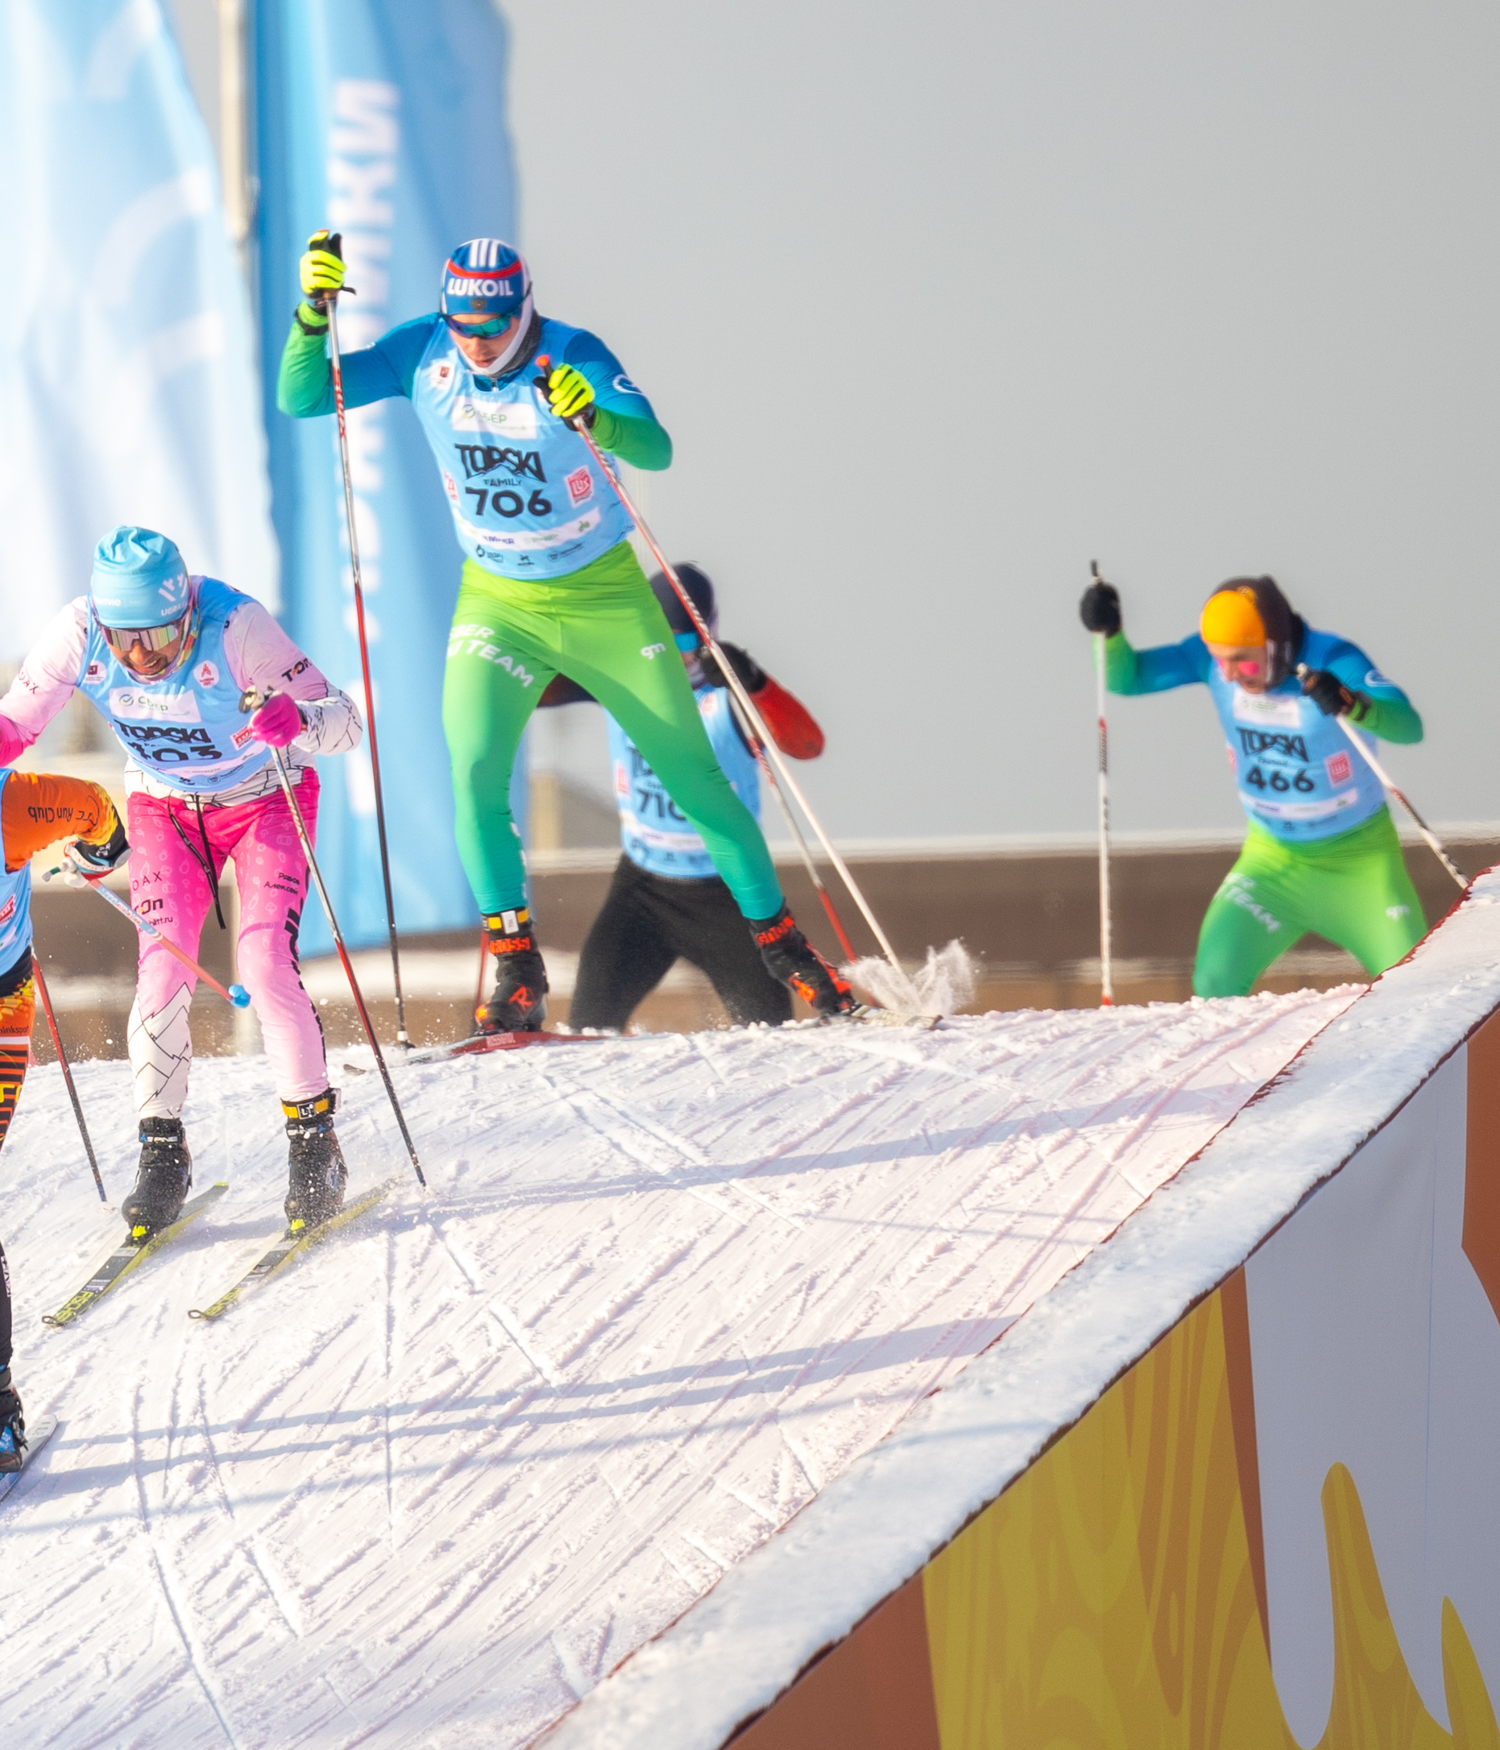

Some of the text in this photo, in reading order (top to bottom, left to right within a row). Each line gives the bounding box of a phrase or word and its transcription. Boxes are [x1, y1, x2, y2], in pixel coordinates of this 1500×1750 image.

[446, 277, 514, 297] LUKOIL
[454, 443, 548, 483] TOPSKI
[483, 478, 522, 487] FAMILY
[465, 487, 553, 518] 706
[465, 639, 535, 688] TEAM
[114, 719, 212, 744] TOPSKI
[1235, 726, 1310, 763] TOPSKI
[1246, 766, 1315, 792] 466
[28, 805, 55, 823] Club
[264, 881, 299, 896] Алексей
